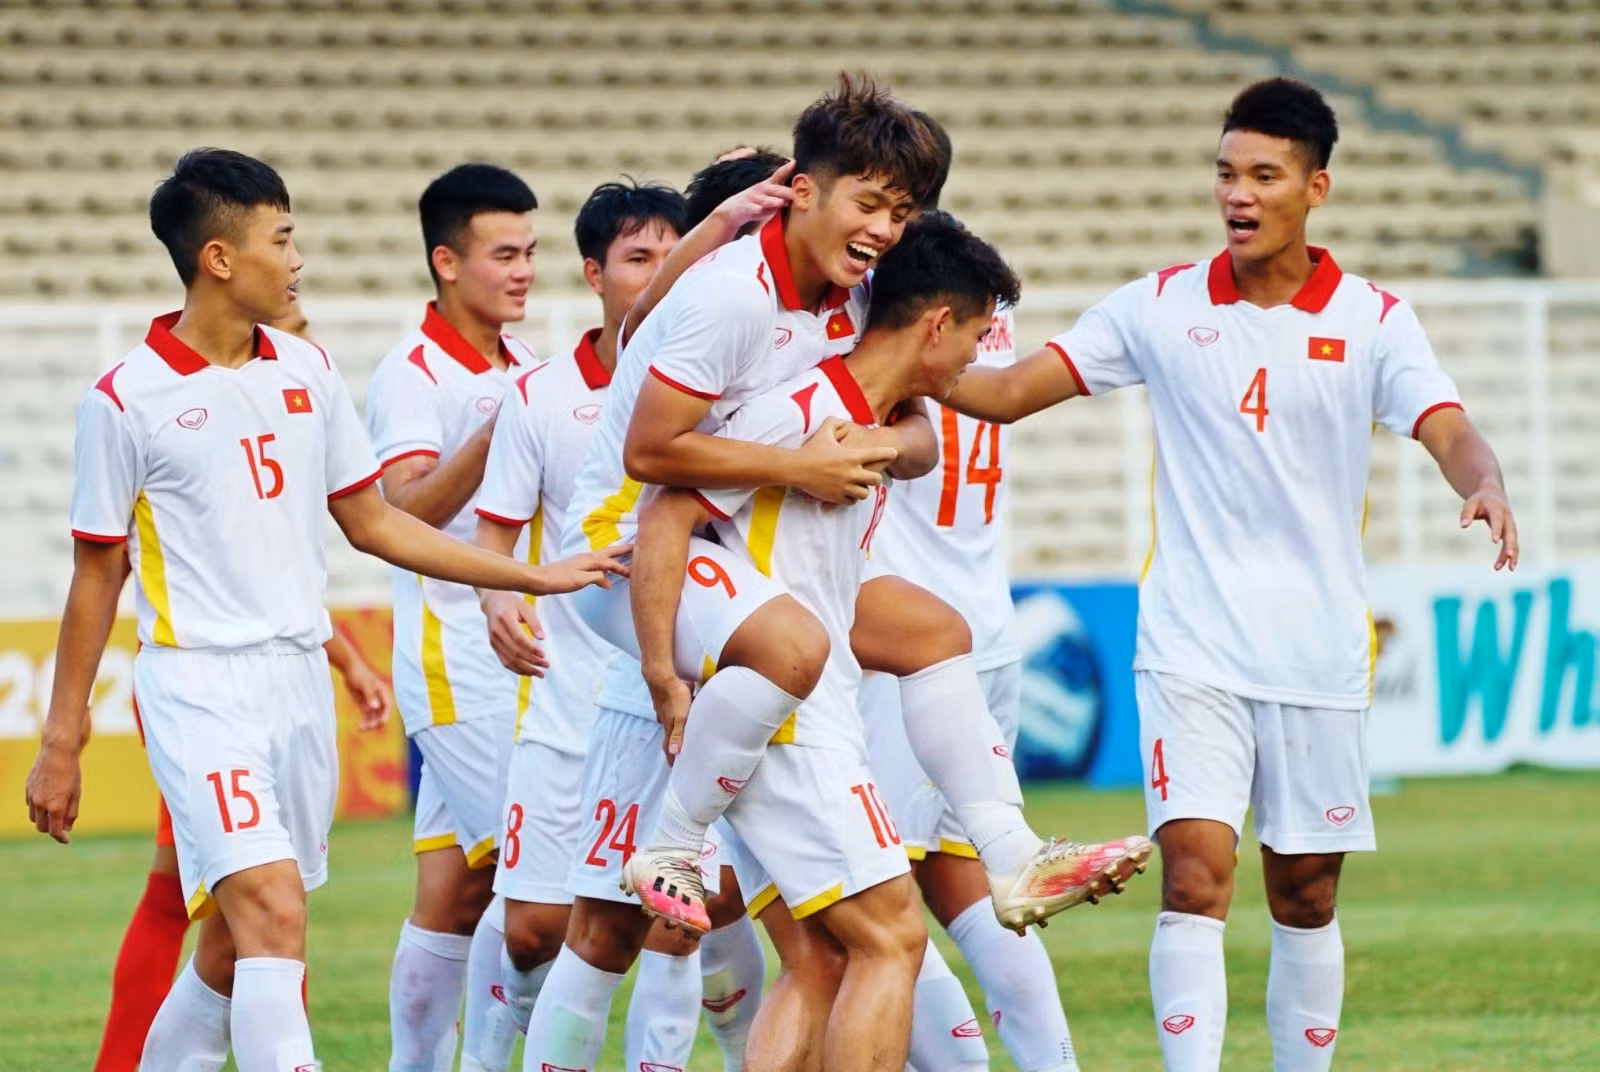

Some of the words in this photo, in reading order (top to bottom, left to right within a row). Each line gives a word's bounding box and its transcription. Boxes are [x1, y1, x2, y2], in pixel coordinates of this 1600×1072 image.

[1240, 367, 1269, 432] 4
[240, 433, 284, 499] 15
[936, 404, 1002, 526] 14
[687, 556, 737, 599] 9
[1433, 577, 1600, 745] Wh
[206, 769, 260, 832] 15
[1152, 738, 1169, 801] 4
[504, 803, 523, 868] 8
[585, 799, 639, 868] 24
